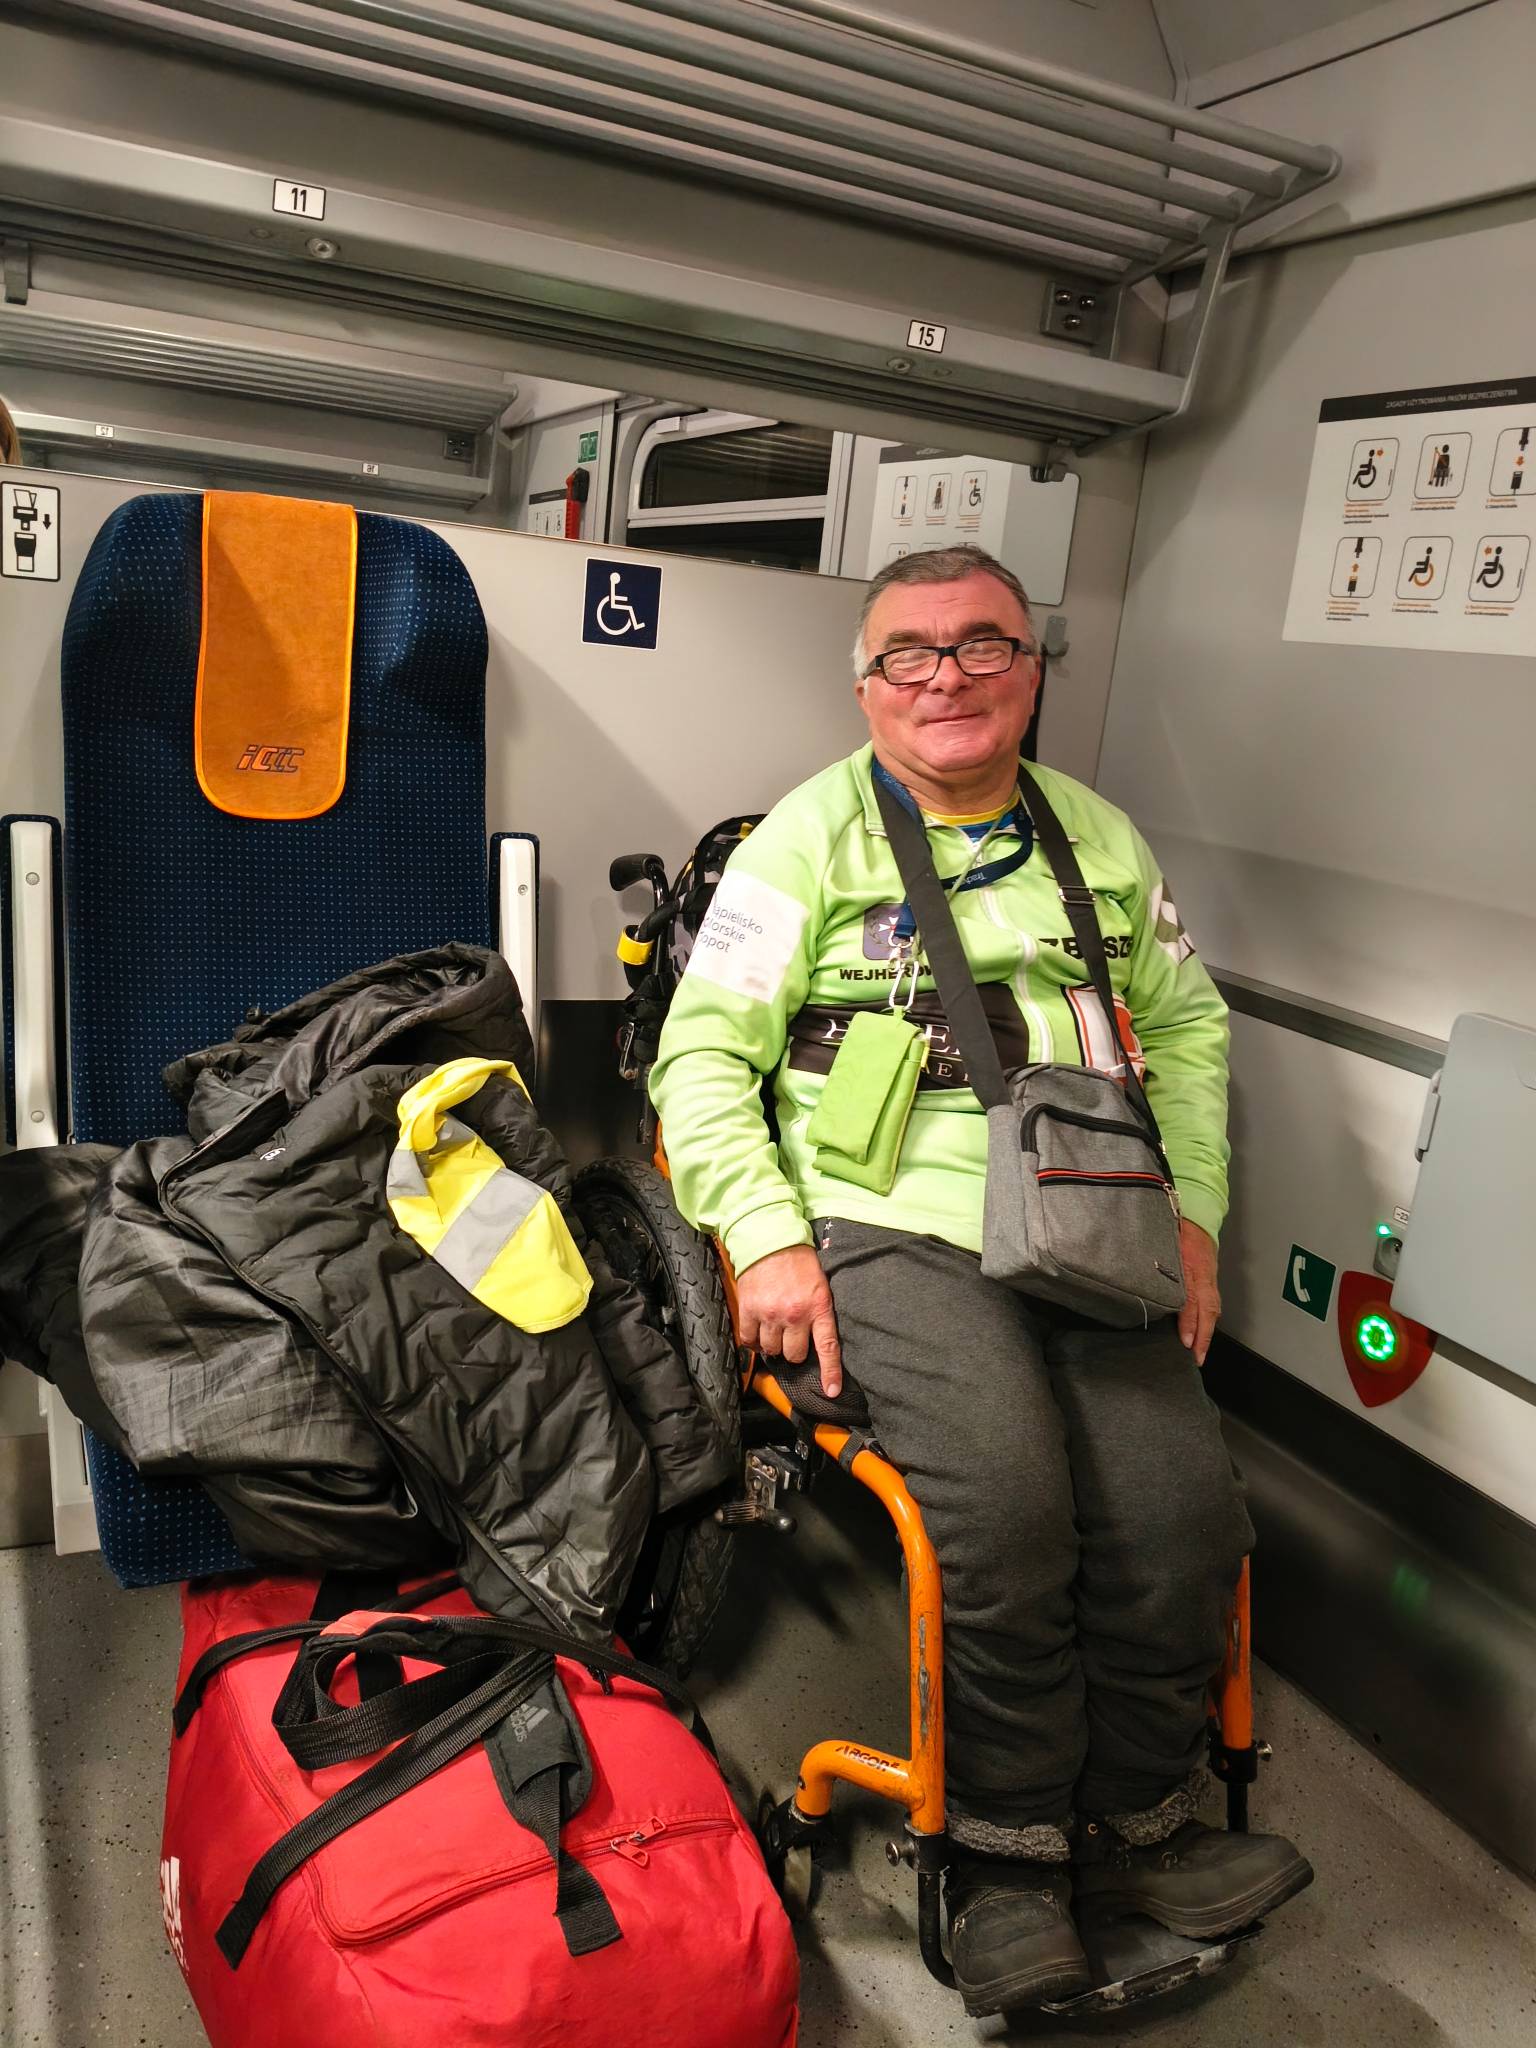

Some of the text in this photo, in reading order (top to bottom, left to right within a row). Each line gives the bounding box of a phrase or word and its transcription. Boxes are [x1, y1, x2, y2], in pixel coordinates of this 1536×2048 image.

[292, 188, 307, 212] 11
[919, 326, 935, 347] 15
[704, 917, 746, 943] orskie
[700, 931, 731, 953] opot
